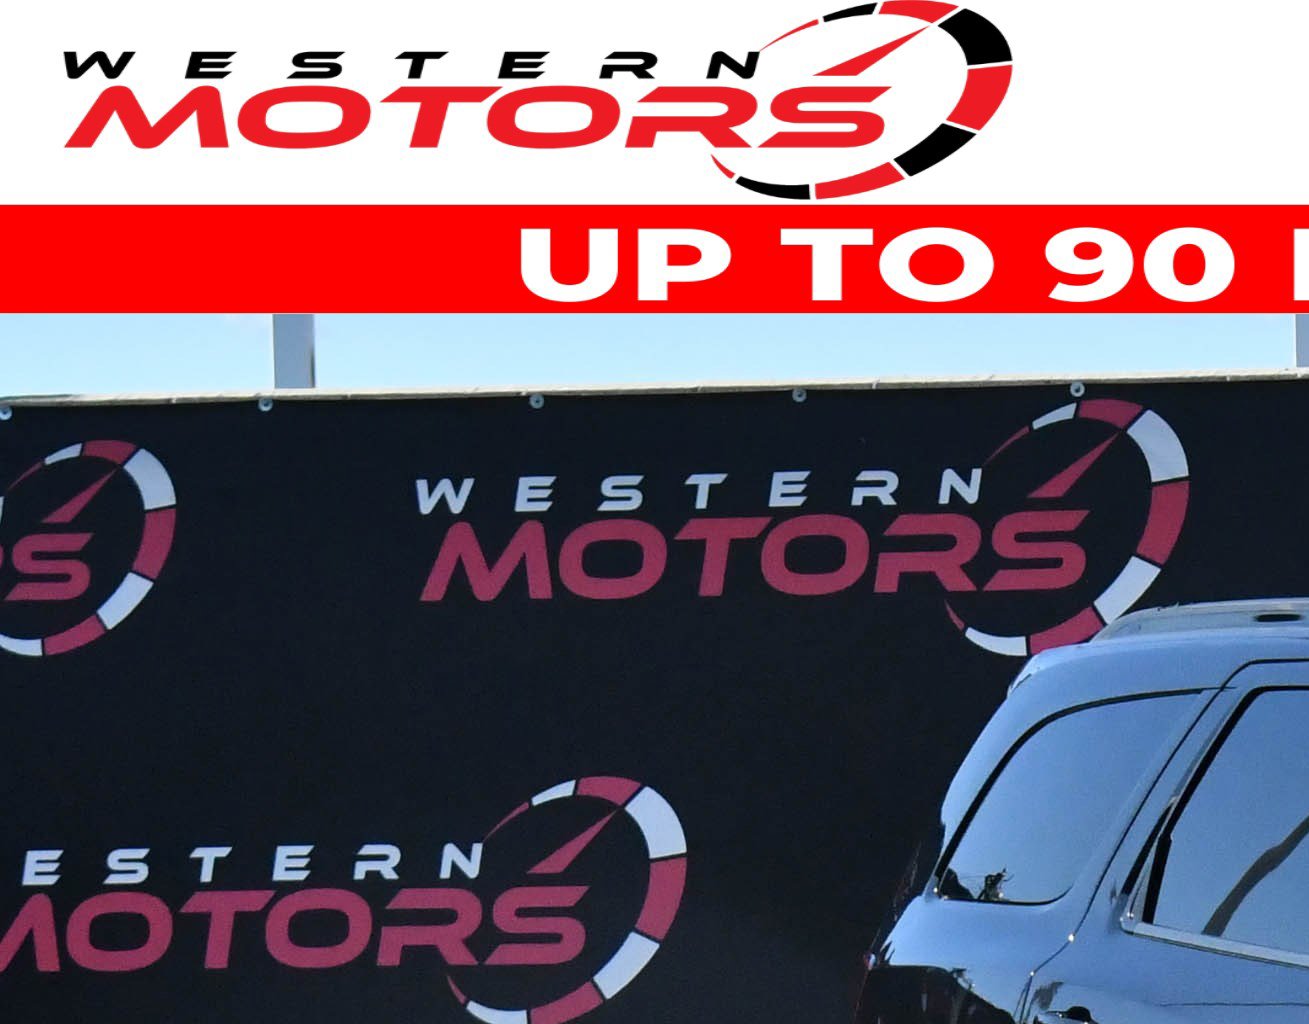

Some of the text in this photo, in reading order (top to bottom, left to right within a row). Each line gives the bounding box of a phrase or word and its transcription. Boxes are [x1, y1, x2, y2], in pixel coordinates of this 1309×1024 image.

[416, 468, 982, 515] WESTERN
[421, 509, 1090, 601] MOTORS
[22, 842, 483, 886] ESTERN
